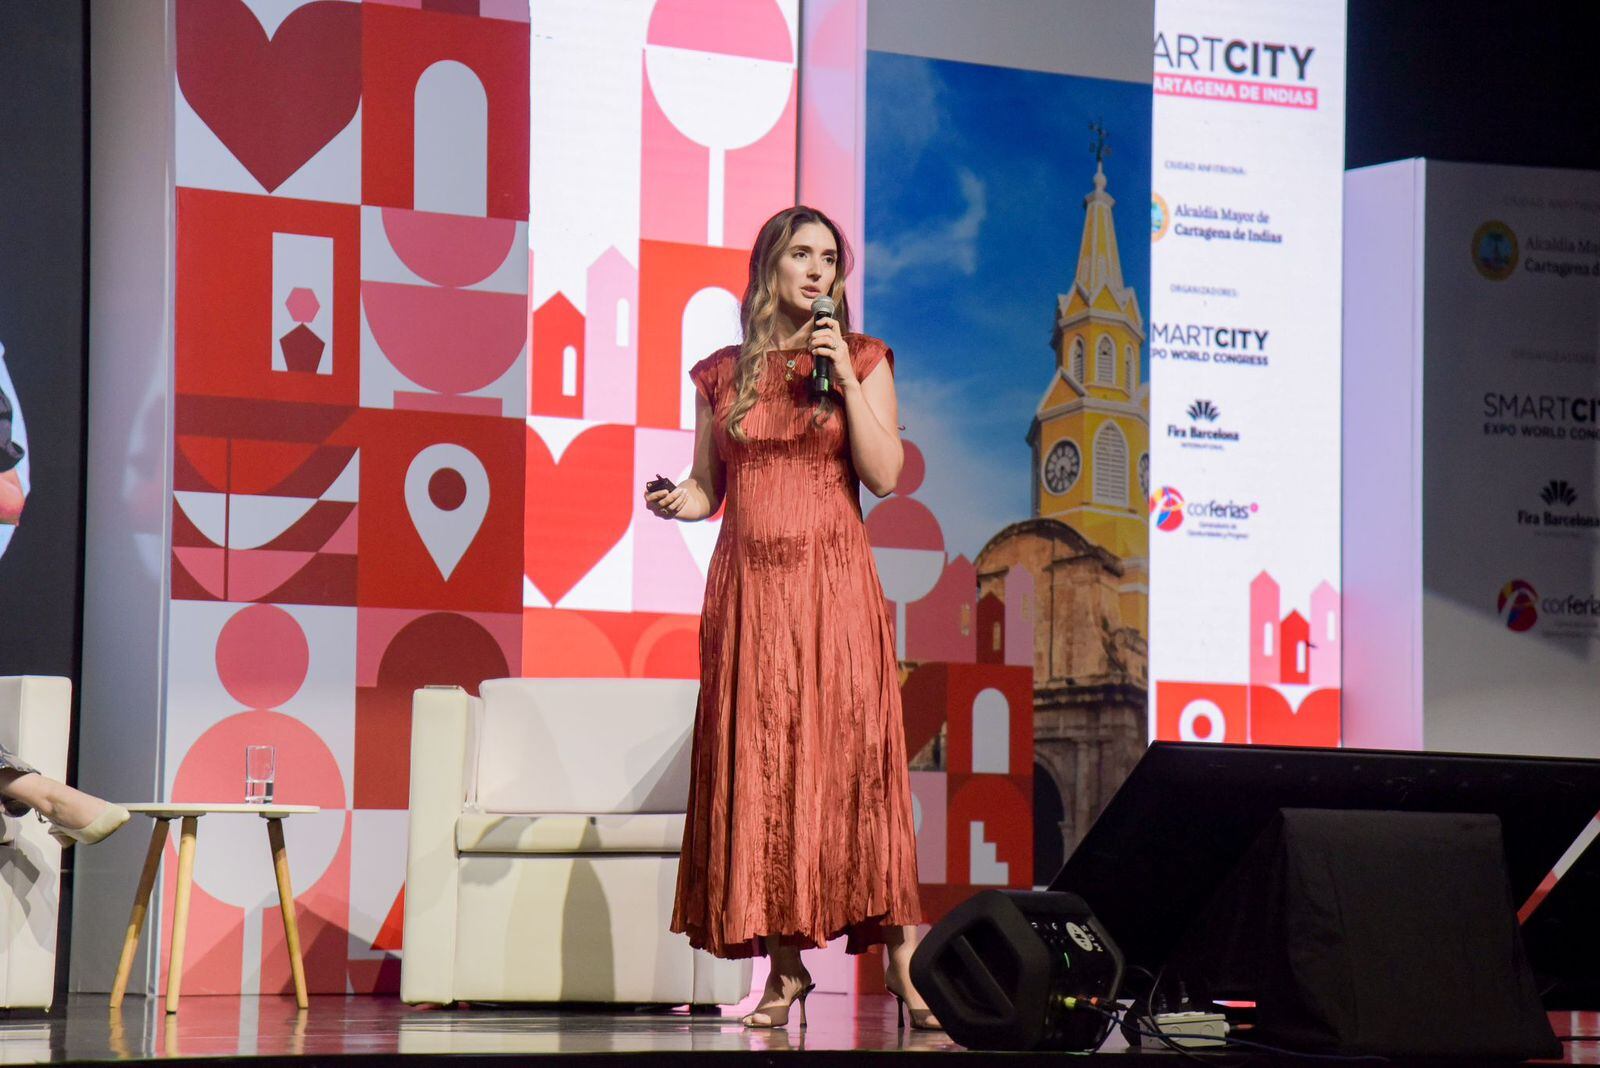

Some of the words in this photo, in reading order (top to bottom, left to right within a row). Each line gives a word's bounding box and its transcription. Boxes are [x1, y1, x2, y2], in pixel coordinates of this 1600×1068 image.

[1240, 84, 1260, 101] DE
[1263, 87, 1315, 106] INDIAS
[1221, 208, 1255, 225] Mayor
[1257, 211, 1270, 224] de
[1174, 223, 1232, 241] Cartagena
[1233, 230, 1246, 240] de
[1248, 229, 1283, 244] Indias
[1525, 257, 1590, 279] Cartagena
[1171, 351, 1210, 363] WORLD
[1213, 353, 1269, 367] CONGRESS
[1167, 425, 1187, 438] Fira
[1190, 426, 1240, 442] Barcelona
[1483, 422, 1517, 436] EXPO
[1522, 424, 1567, 440] WORLD
[1187, 499, 1249, 520] corferias
[1518, 510, 1540, 525] Fira
[1544, 511, 1600, 528] Barcelona
